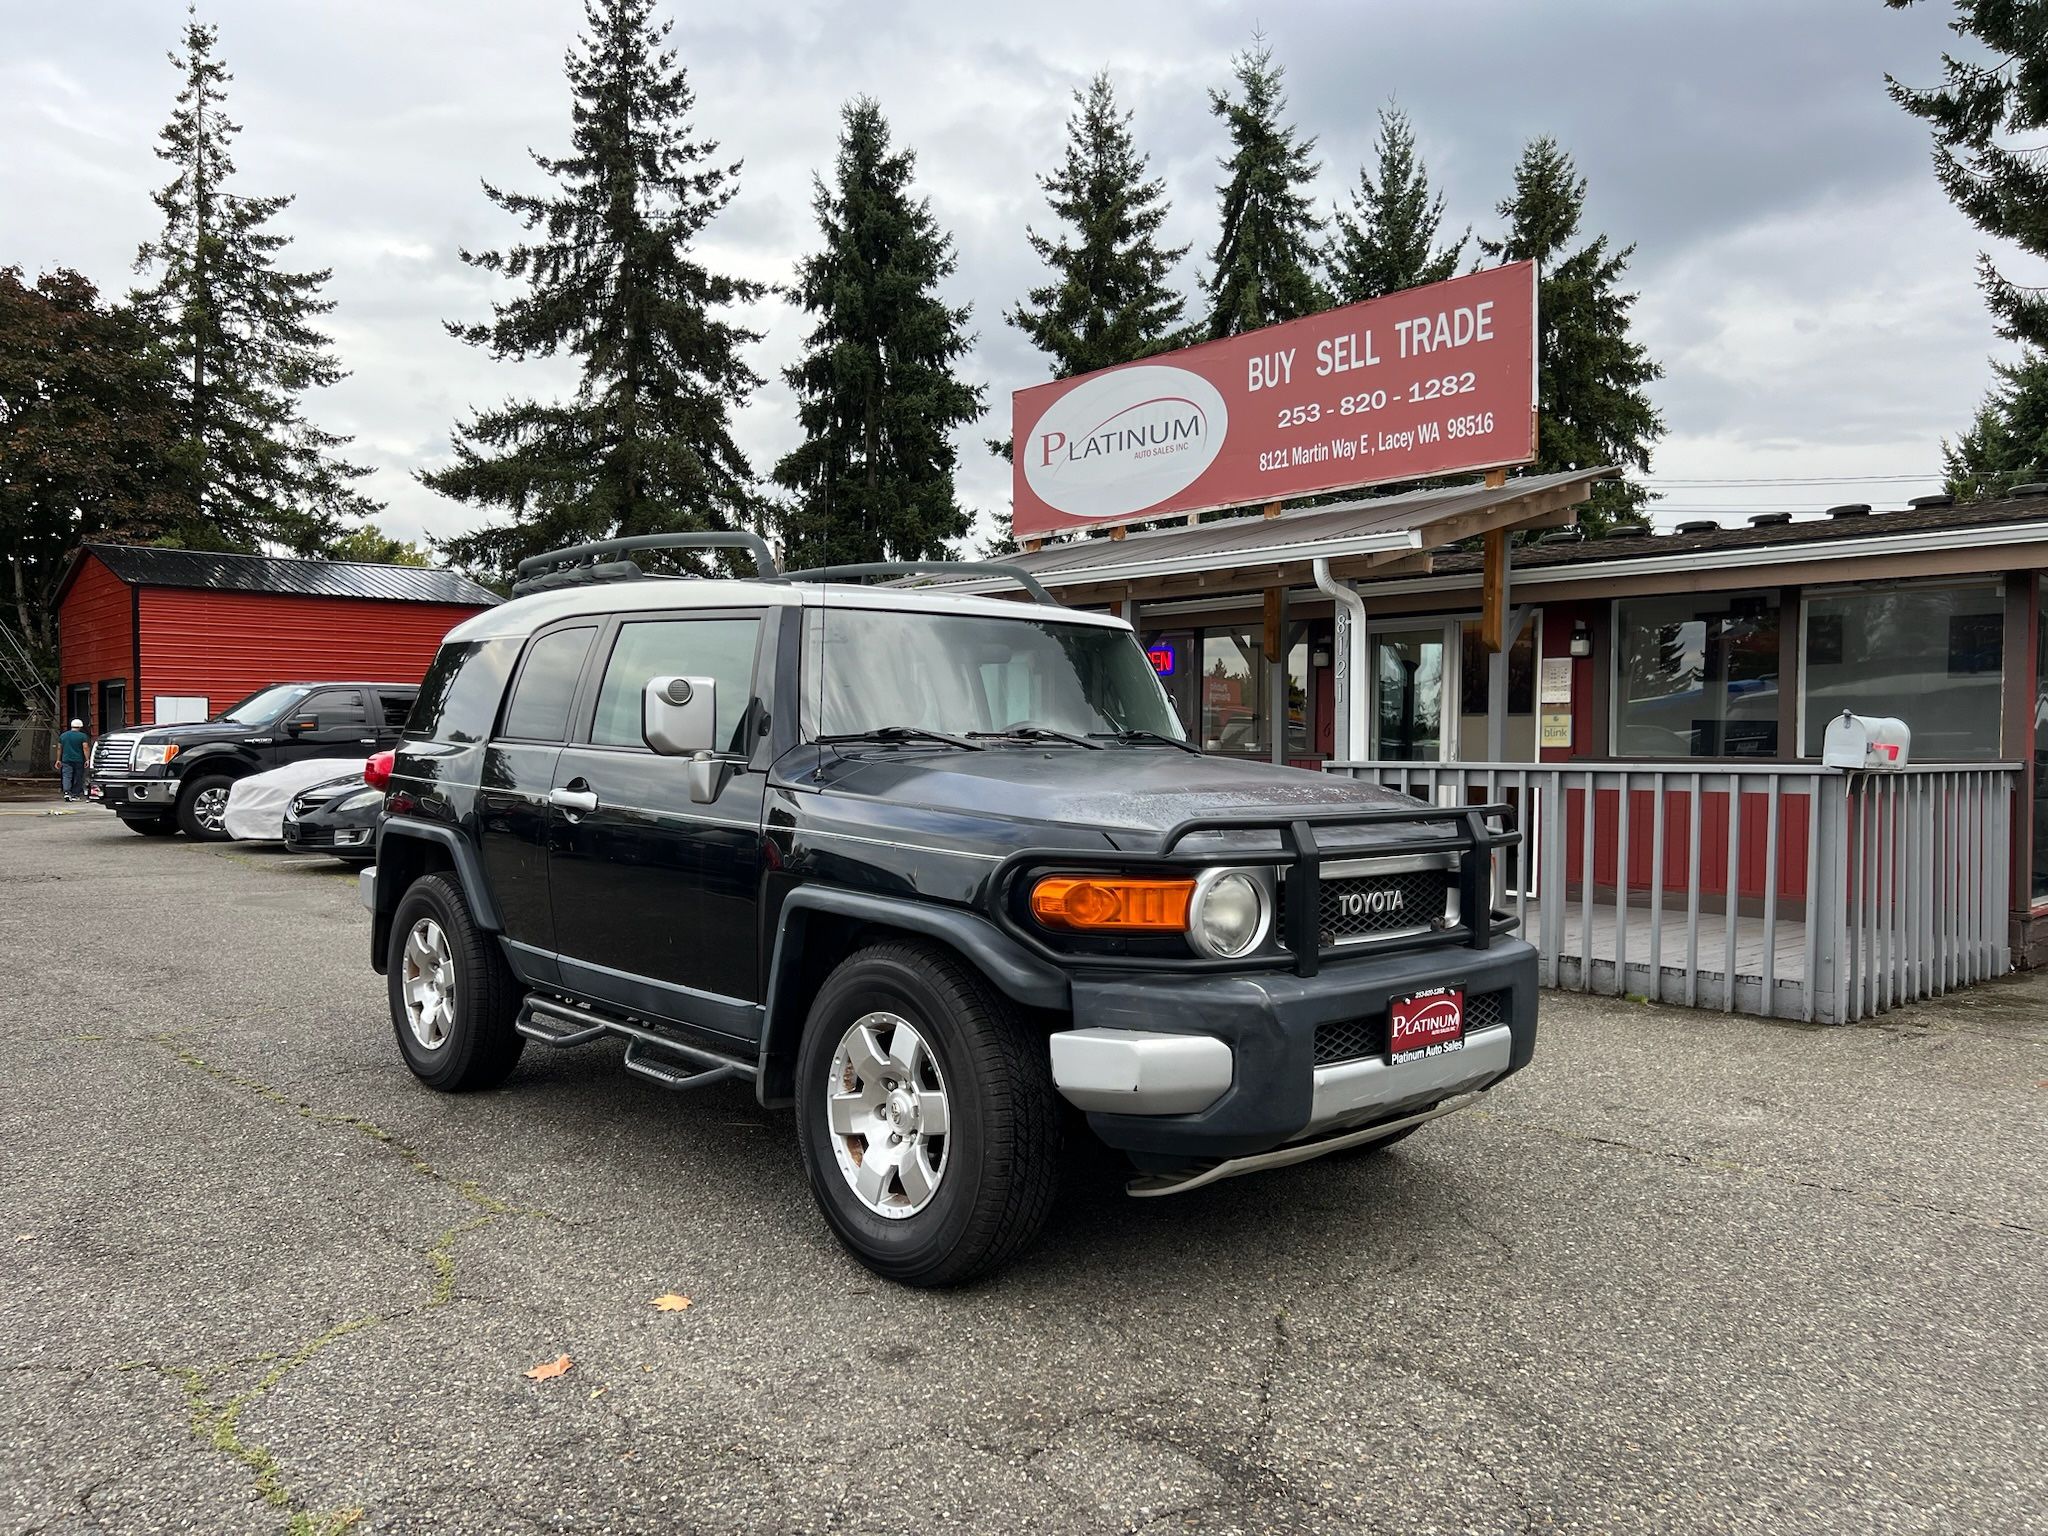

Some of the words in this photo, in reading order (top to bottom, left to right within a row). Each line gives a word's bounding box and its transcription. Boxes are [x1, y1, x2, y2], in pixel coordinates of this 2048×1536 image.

[1248, 348, 1297, 392] BUY
[1316, 329, 1381, 377] SELL
[1394, 300, 1495, 359] TRADE
[1277, 403, 1322, 430] 253
[1339, 389, 1388, 416] 820
[1408, 371, 1477, 403] 1282
[1040, 415, 1201, 467] PLATINUM
[1134, 449, 1151, 460] AUTO
[1152, 445, 1175, 457] SALES
[1176, 441, 1190, 451] INC
[1259, 450, 1290, 472] 8121
[1291, 445, 1329, 467] Martin
[1331, 438, 1358, 461] Way
[1378, 430, 1415, 451] Lacey
[1417, 421, 1441, 444] WA
[1447, 411, 1495, 440] 98516
[1148, 651, 1172, 672] EN
[1336, 614, 1347, 704] 8121
[1339, 889, 1404, 916] TOYOTA
[1392, 1013, 1459, 1038] PLATINUM
[1391, 1051, 1424, 1066] Platinum
[1425, 1045, 1443, 1057] Auto
[1443, 1040, 1463, 1053] Sales
